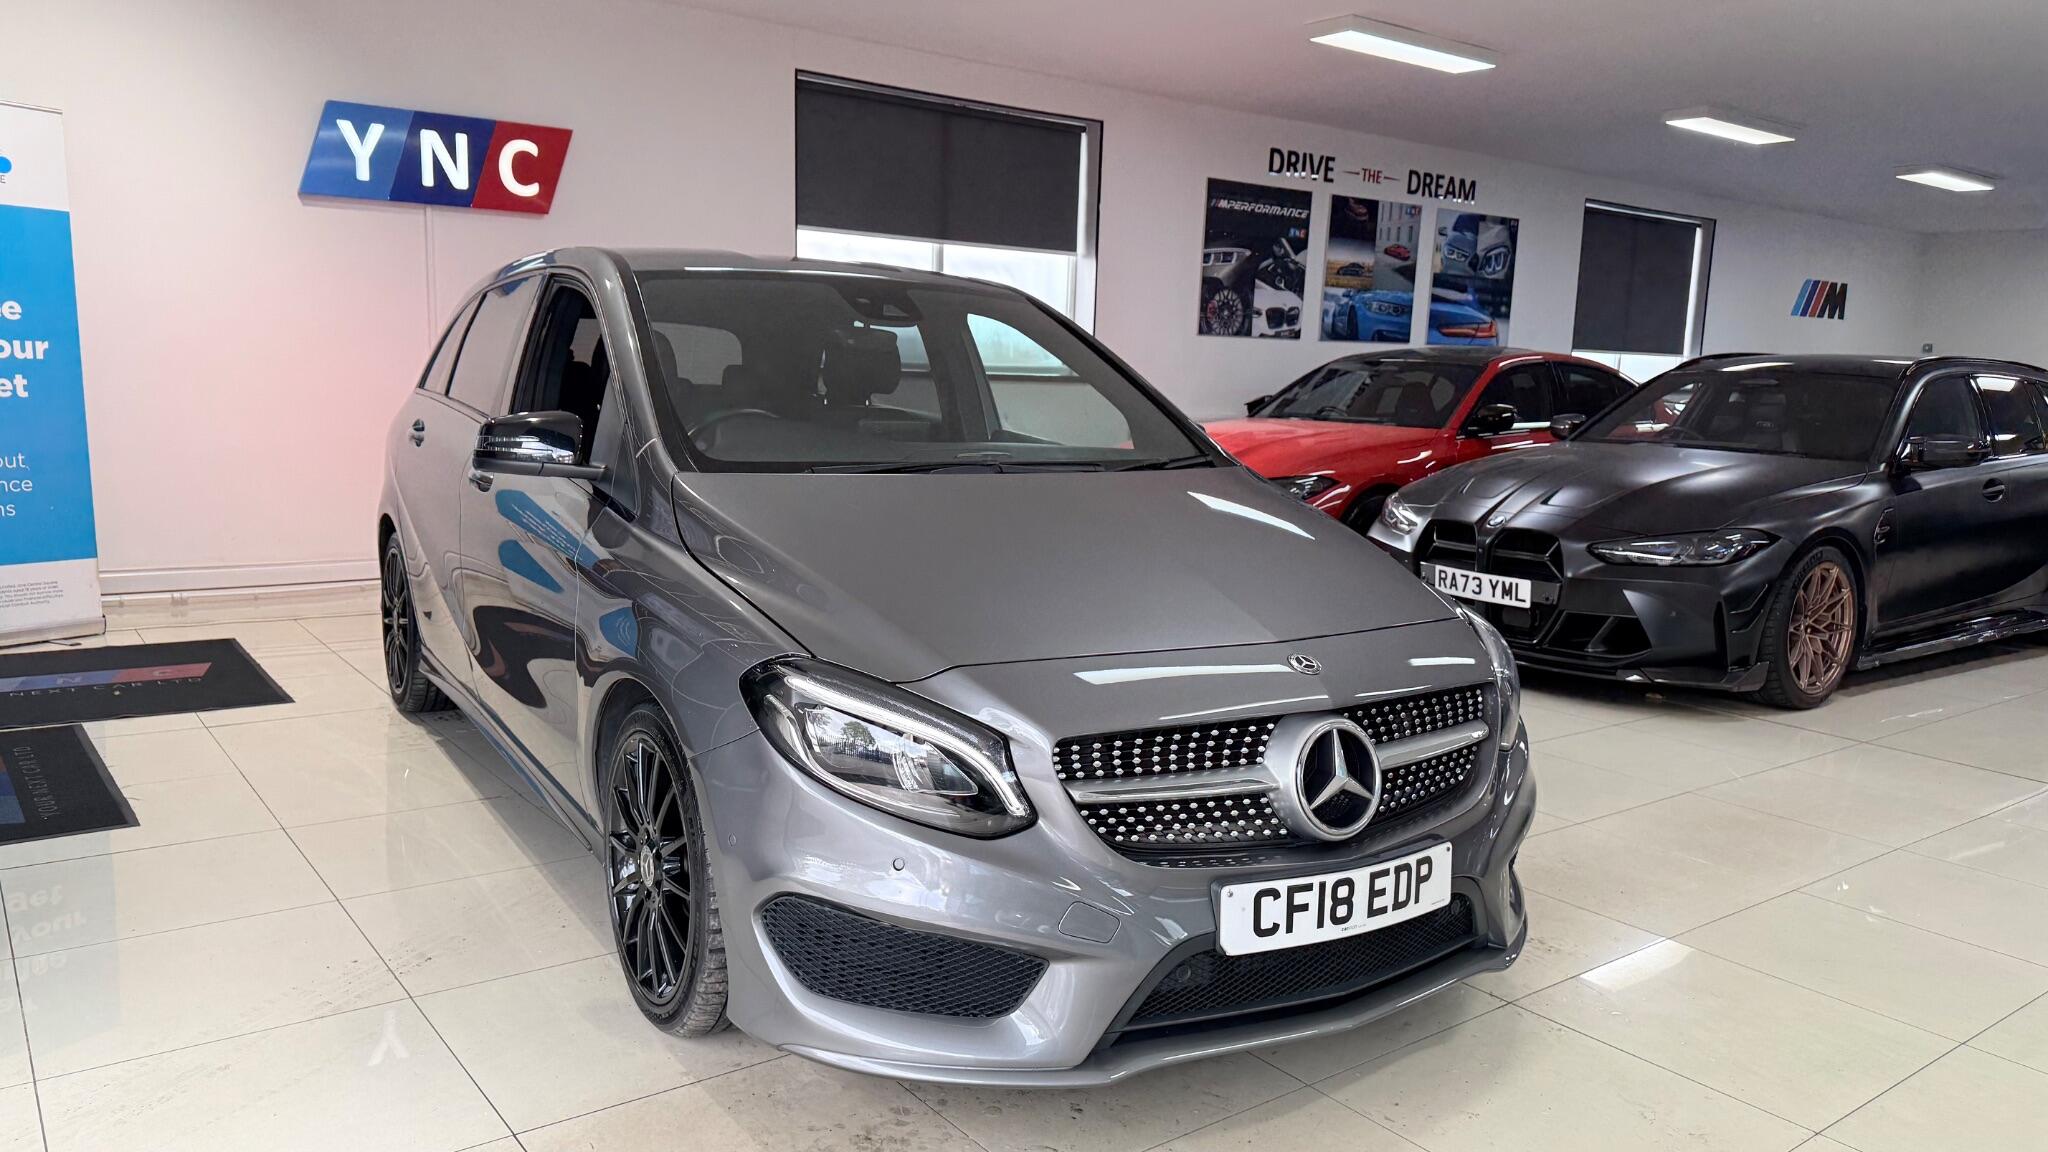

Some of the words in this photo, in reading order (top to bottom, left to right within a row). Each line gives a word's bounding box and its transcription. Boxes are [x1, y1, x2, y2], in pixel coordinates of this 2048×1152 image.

[336, 118, 540, 197] YNC
[1268, 147, 1336, 183] DRIVE
[1361, 168, 1383, 184] THE
[1406, 169, 1477, 203] DREAM
[0, 300, 22, 320] e
[0, 452, 30, 471] ut,
[1438, 569, 1482, 595] RA73
[1489, 578, 1527, 603] YML
[1253, 876, 1355, 938] CF18
[1367, 855, 1433, 919] EDP
